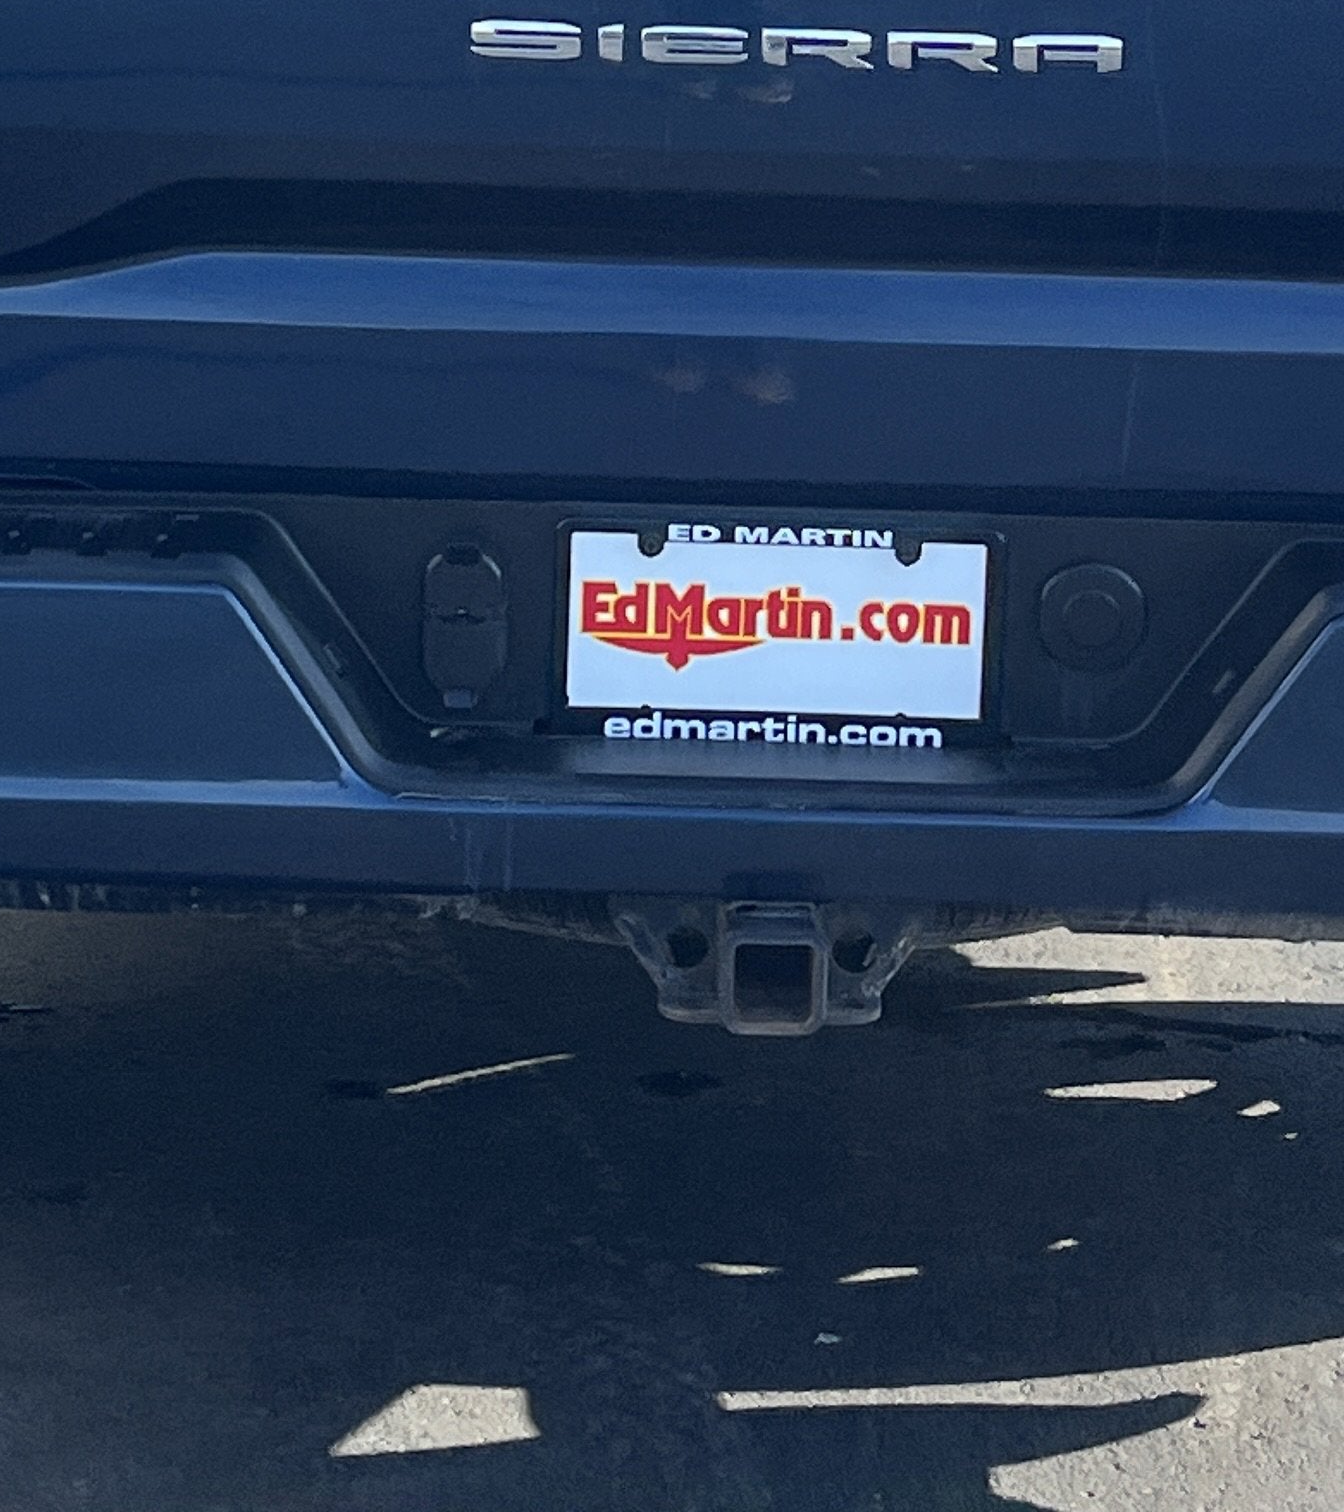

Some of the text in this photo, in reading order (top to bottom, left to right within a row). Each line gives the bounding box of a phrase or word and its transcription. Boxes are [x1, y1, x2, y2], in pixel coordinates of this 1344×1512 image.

[469, 19, 1124, 73] SIERRA
[667, 523, 894, 548] ED MARTIN
[603, 712, 943, 748] edmartin.com
